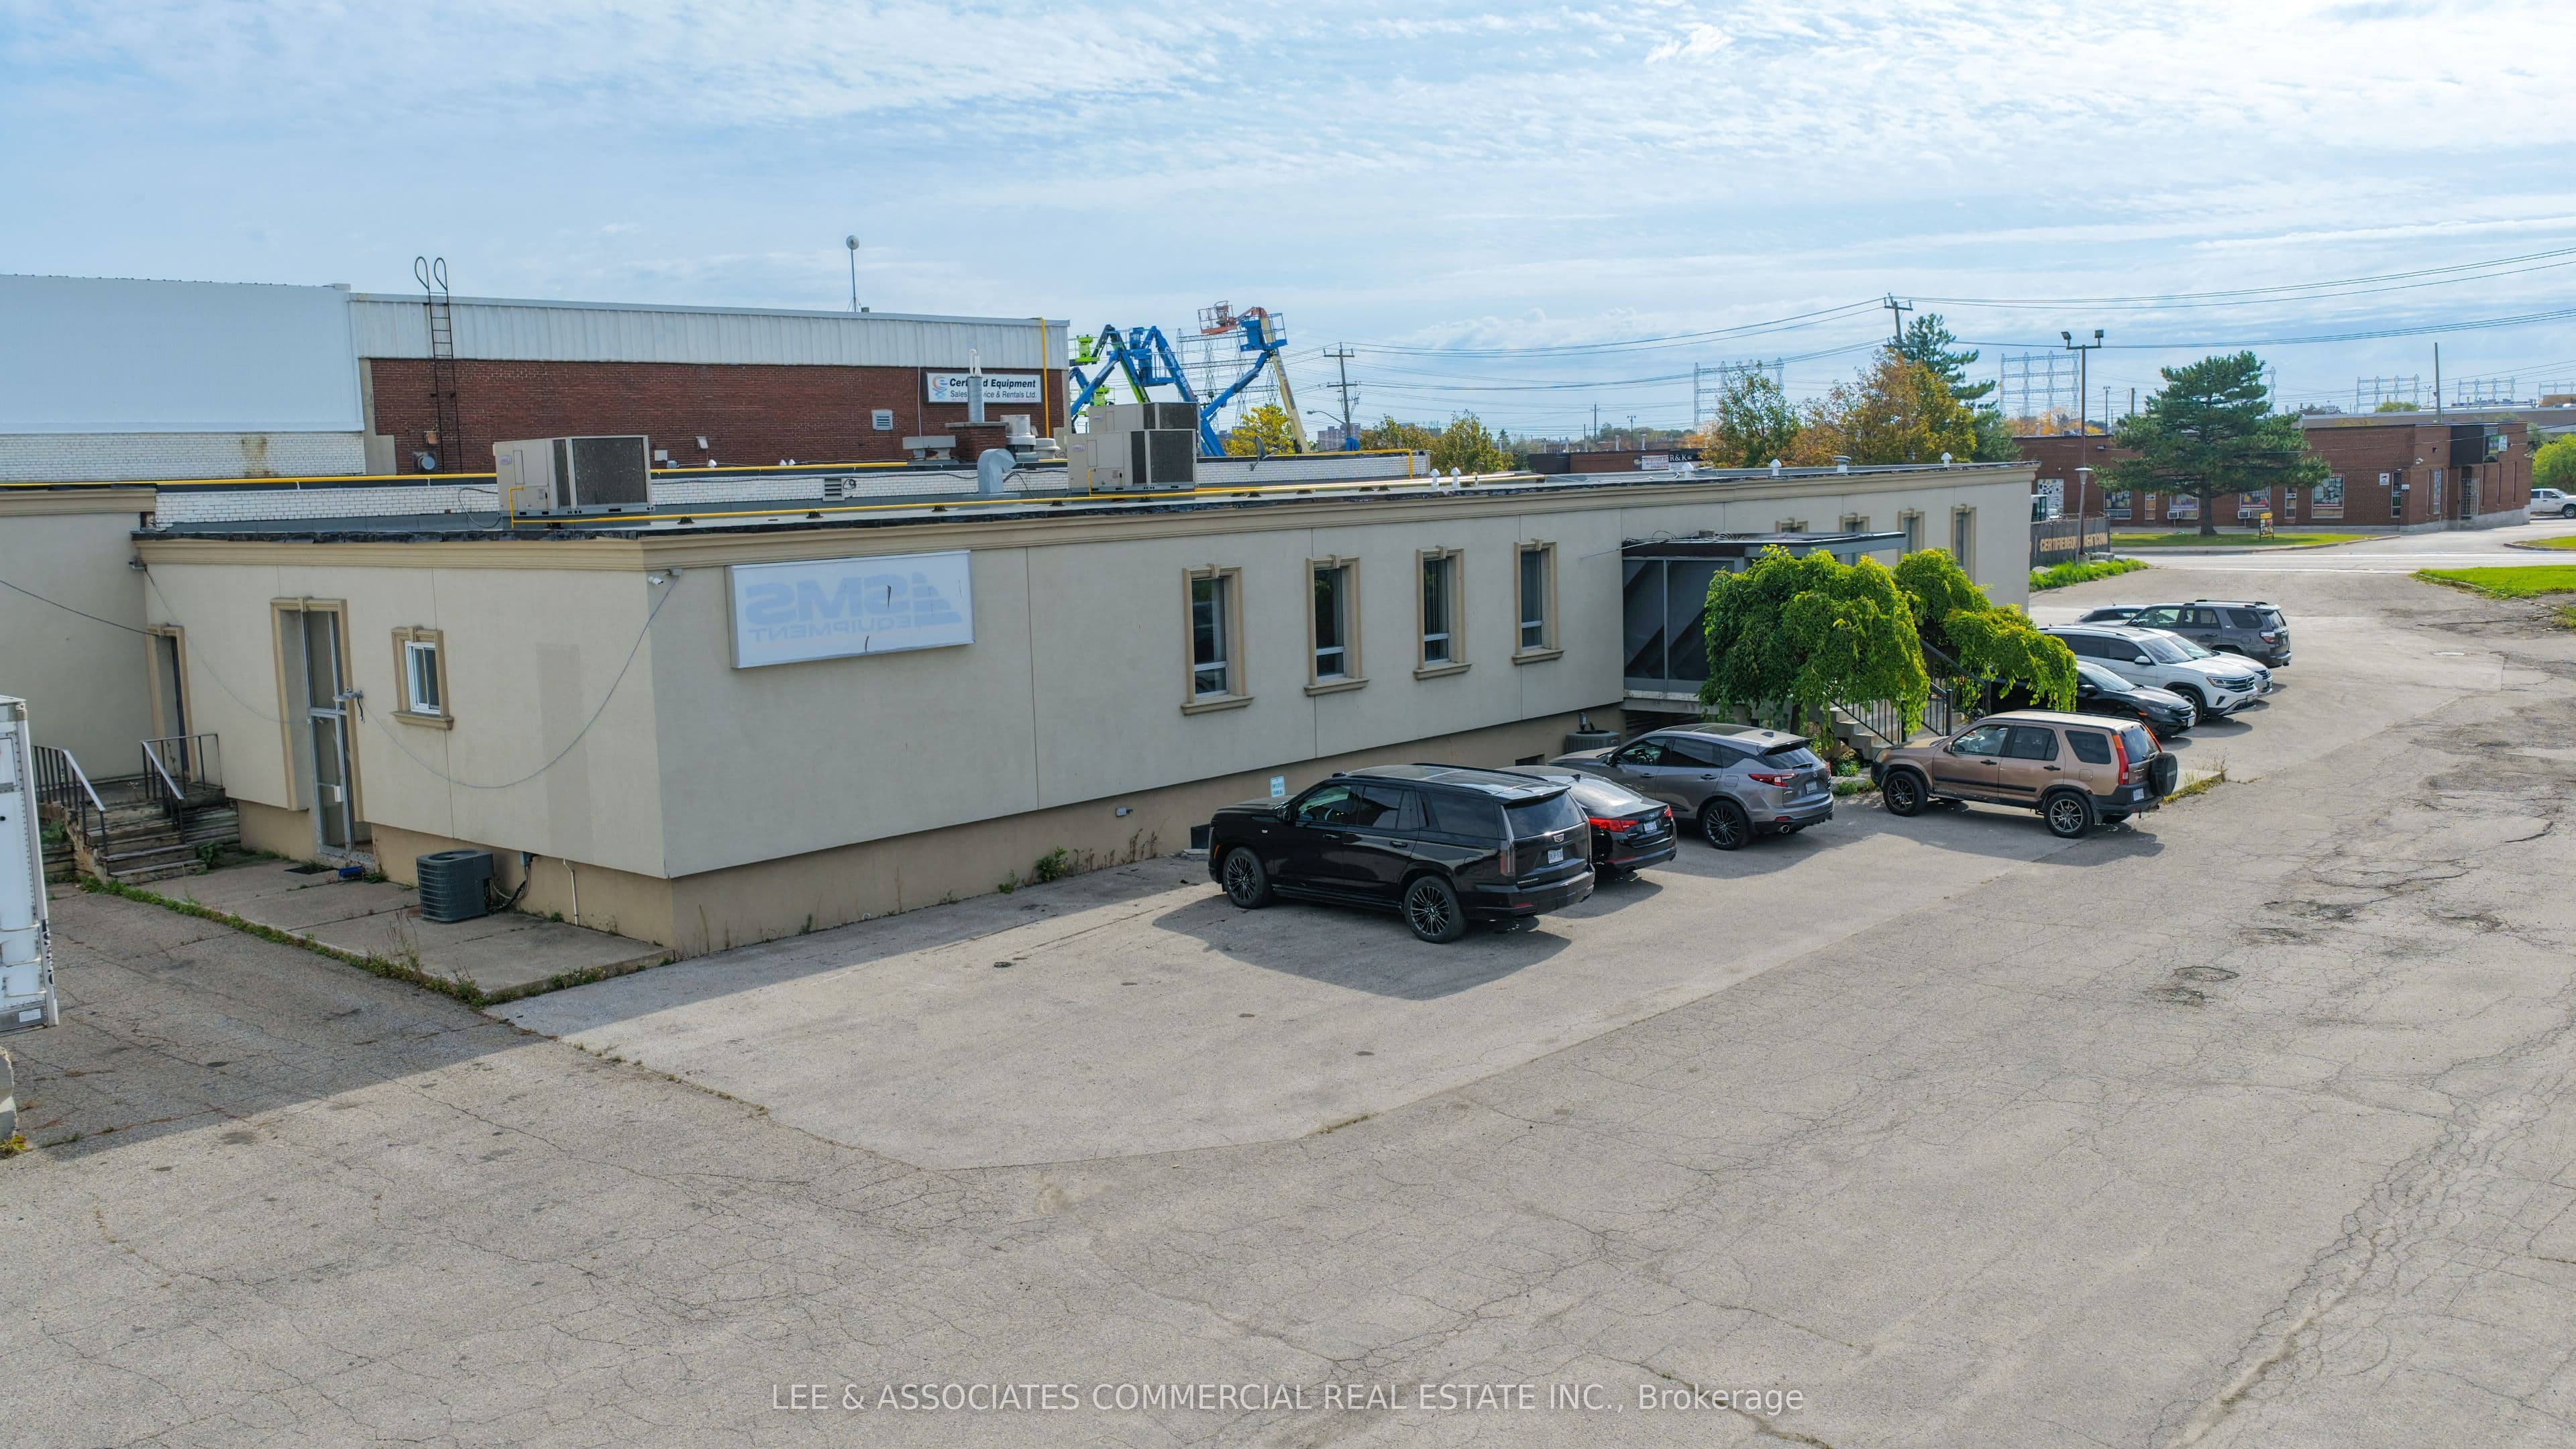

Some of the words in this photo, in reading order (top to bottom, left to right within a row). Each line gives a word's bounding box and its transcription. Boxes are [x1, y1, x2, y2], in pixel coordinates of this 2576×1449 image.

[991, 378, 1036, 390] Equipment
[1002, 390, 1024, 398] Rentals
[1026, 390, 1037, 398] Ltd.
